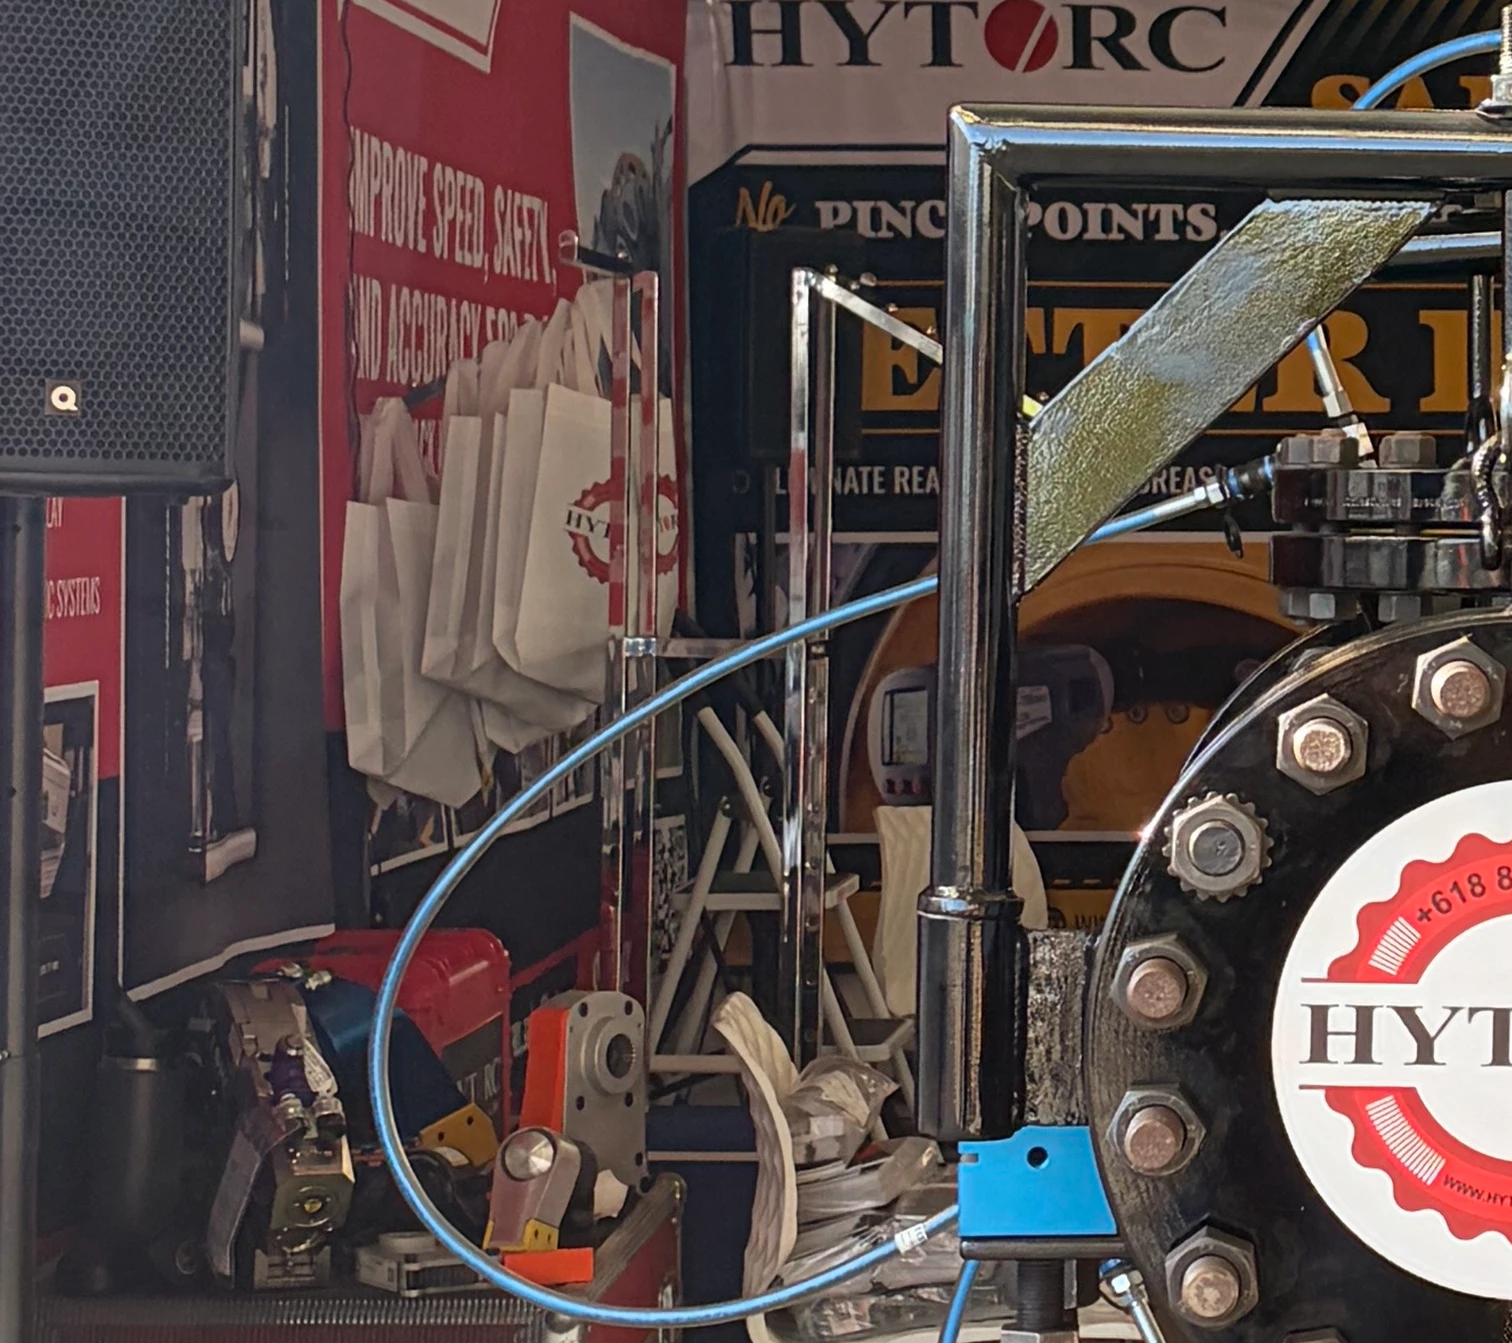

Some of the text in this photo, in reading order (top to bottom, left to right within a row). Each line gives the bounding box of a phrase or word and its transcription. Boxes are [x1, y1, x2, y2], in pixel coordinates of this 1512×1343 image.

[735, 180, 796, 232] No
[815, 200, 945, 238] PINC
[1417, 873, 1486, 922] +618
